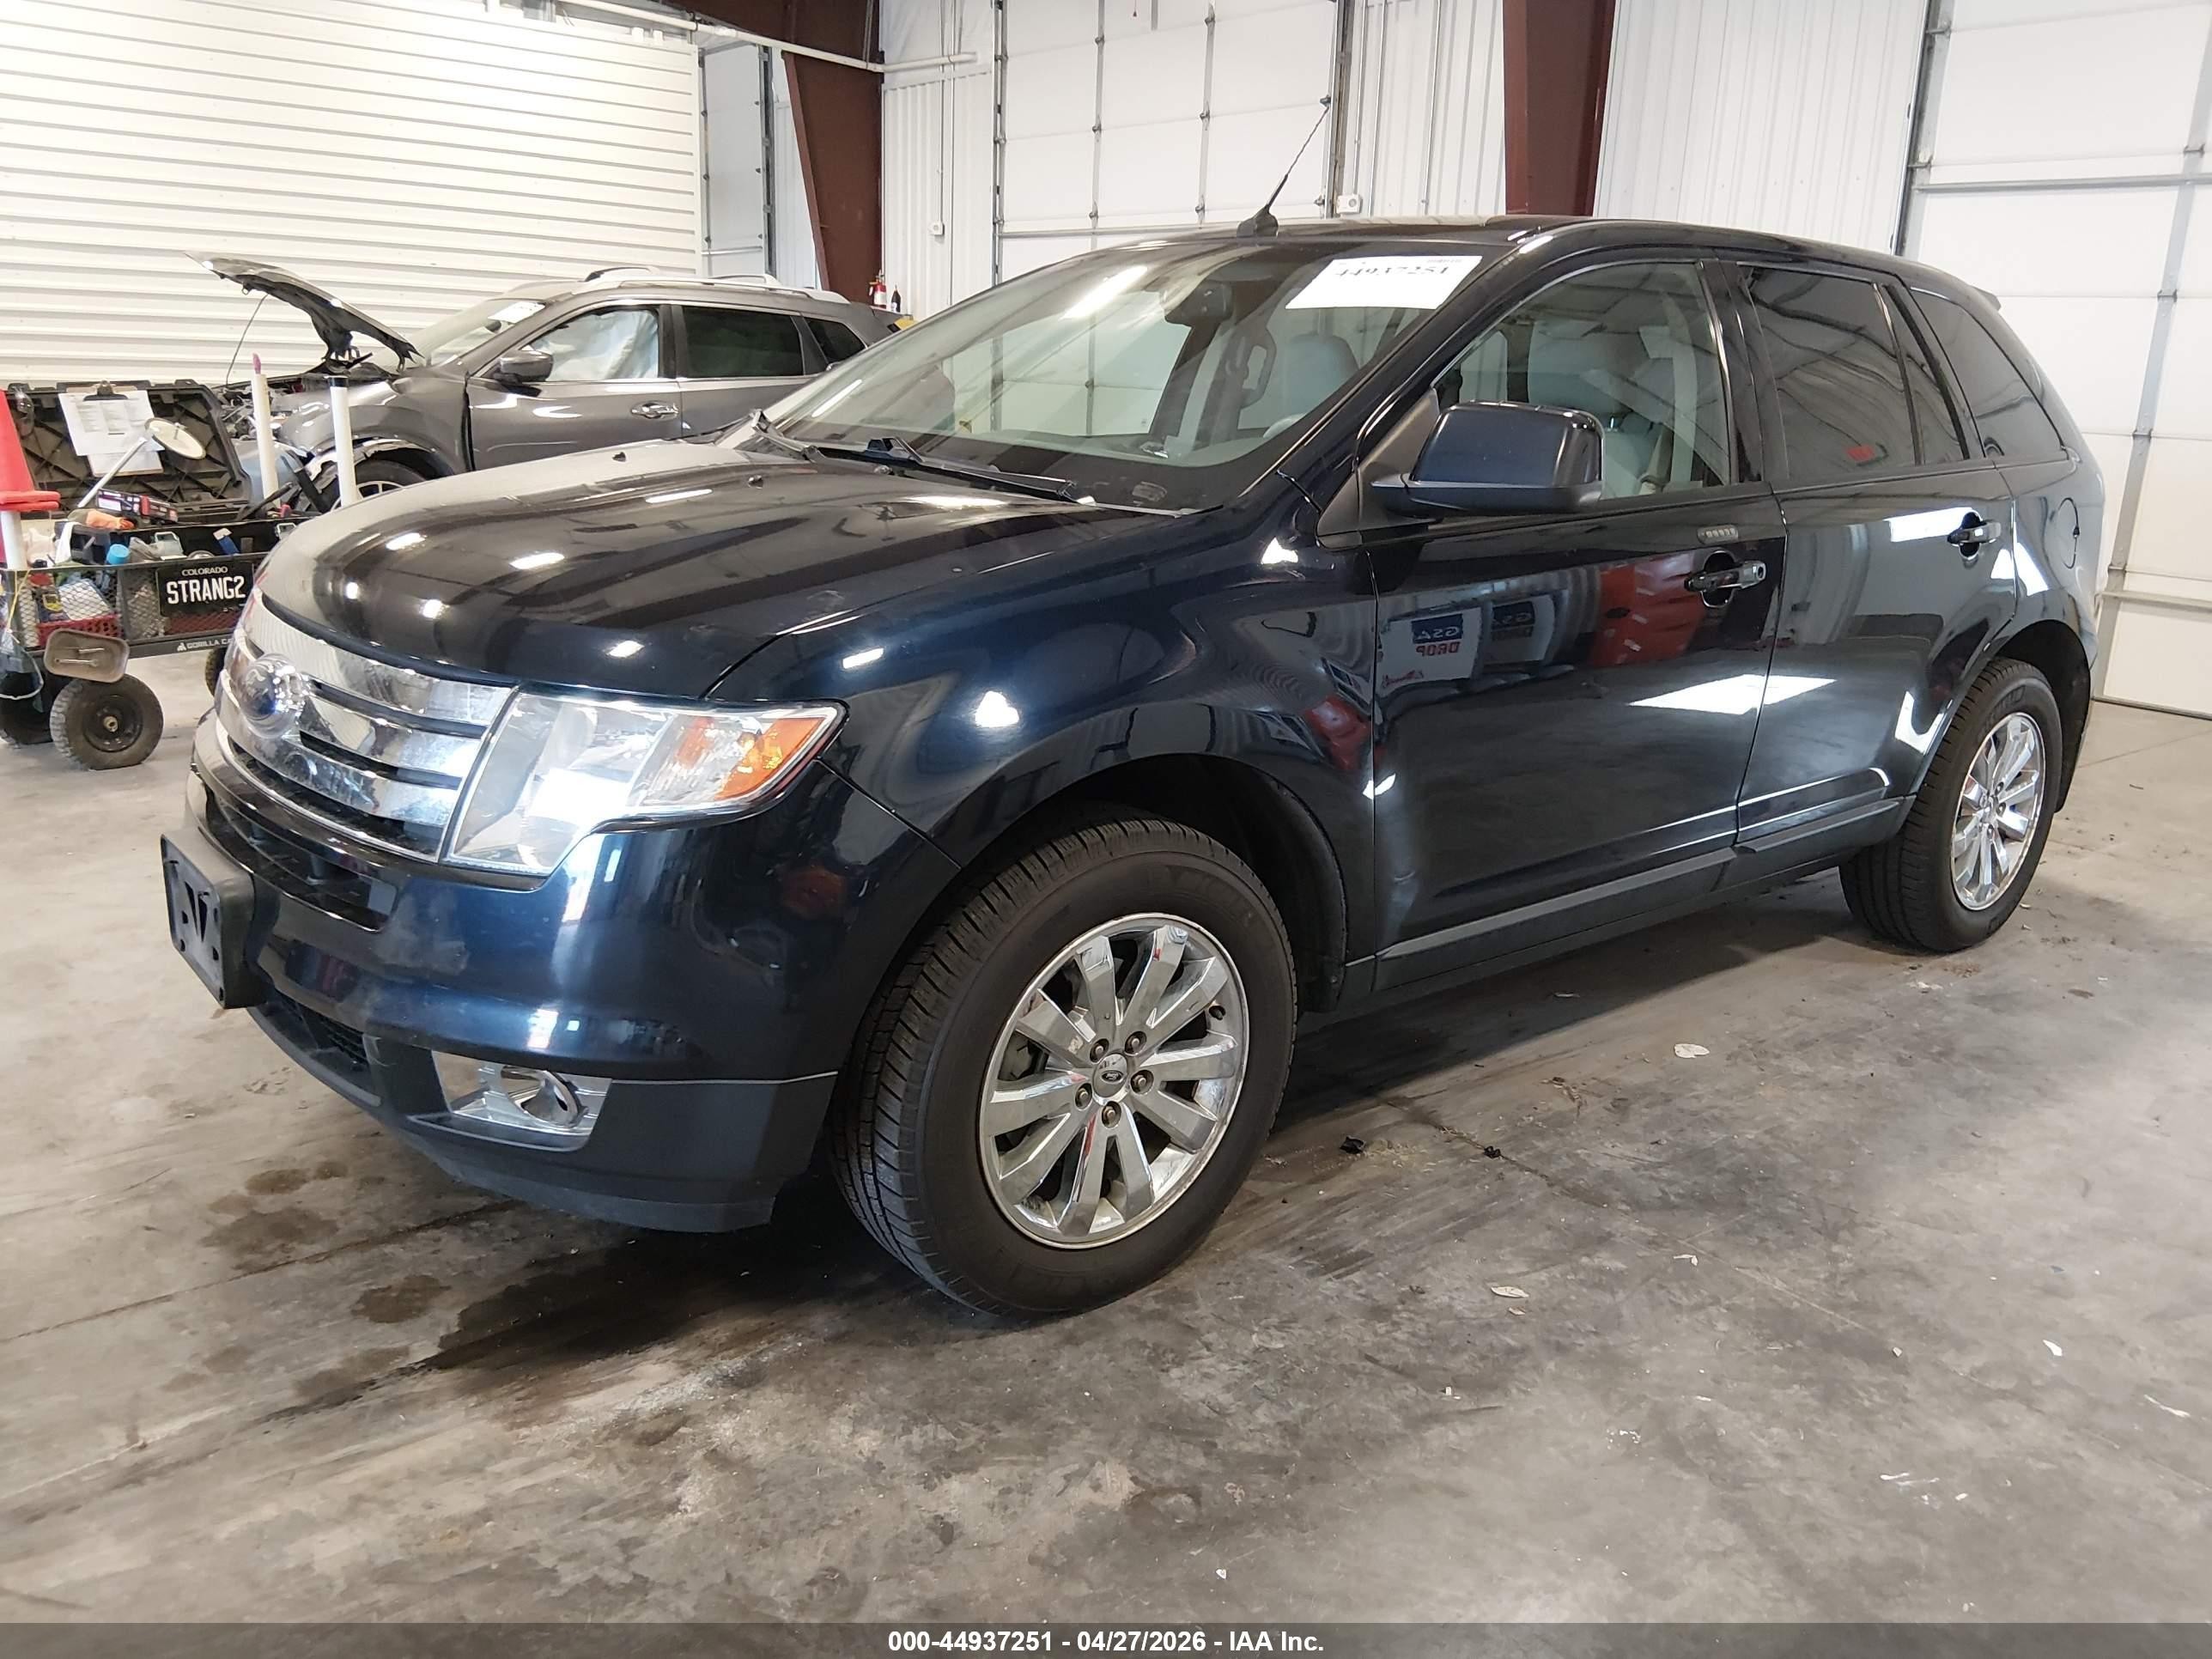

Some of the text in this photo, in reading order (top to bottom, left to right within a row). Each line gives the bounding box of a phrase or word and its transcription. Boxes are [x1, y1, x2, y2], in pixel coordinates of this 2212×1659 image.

[181, 566, 228, 576] COLORADO
[166, 575, 246, 604] STRANG2
[186, 640, 220, 649] GORILLA
